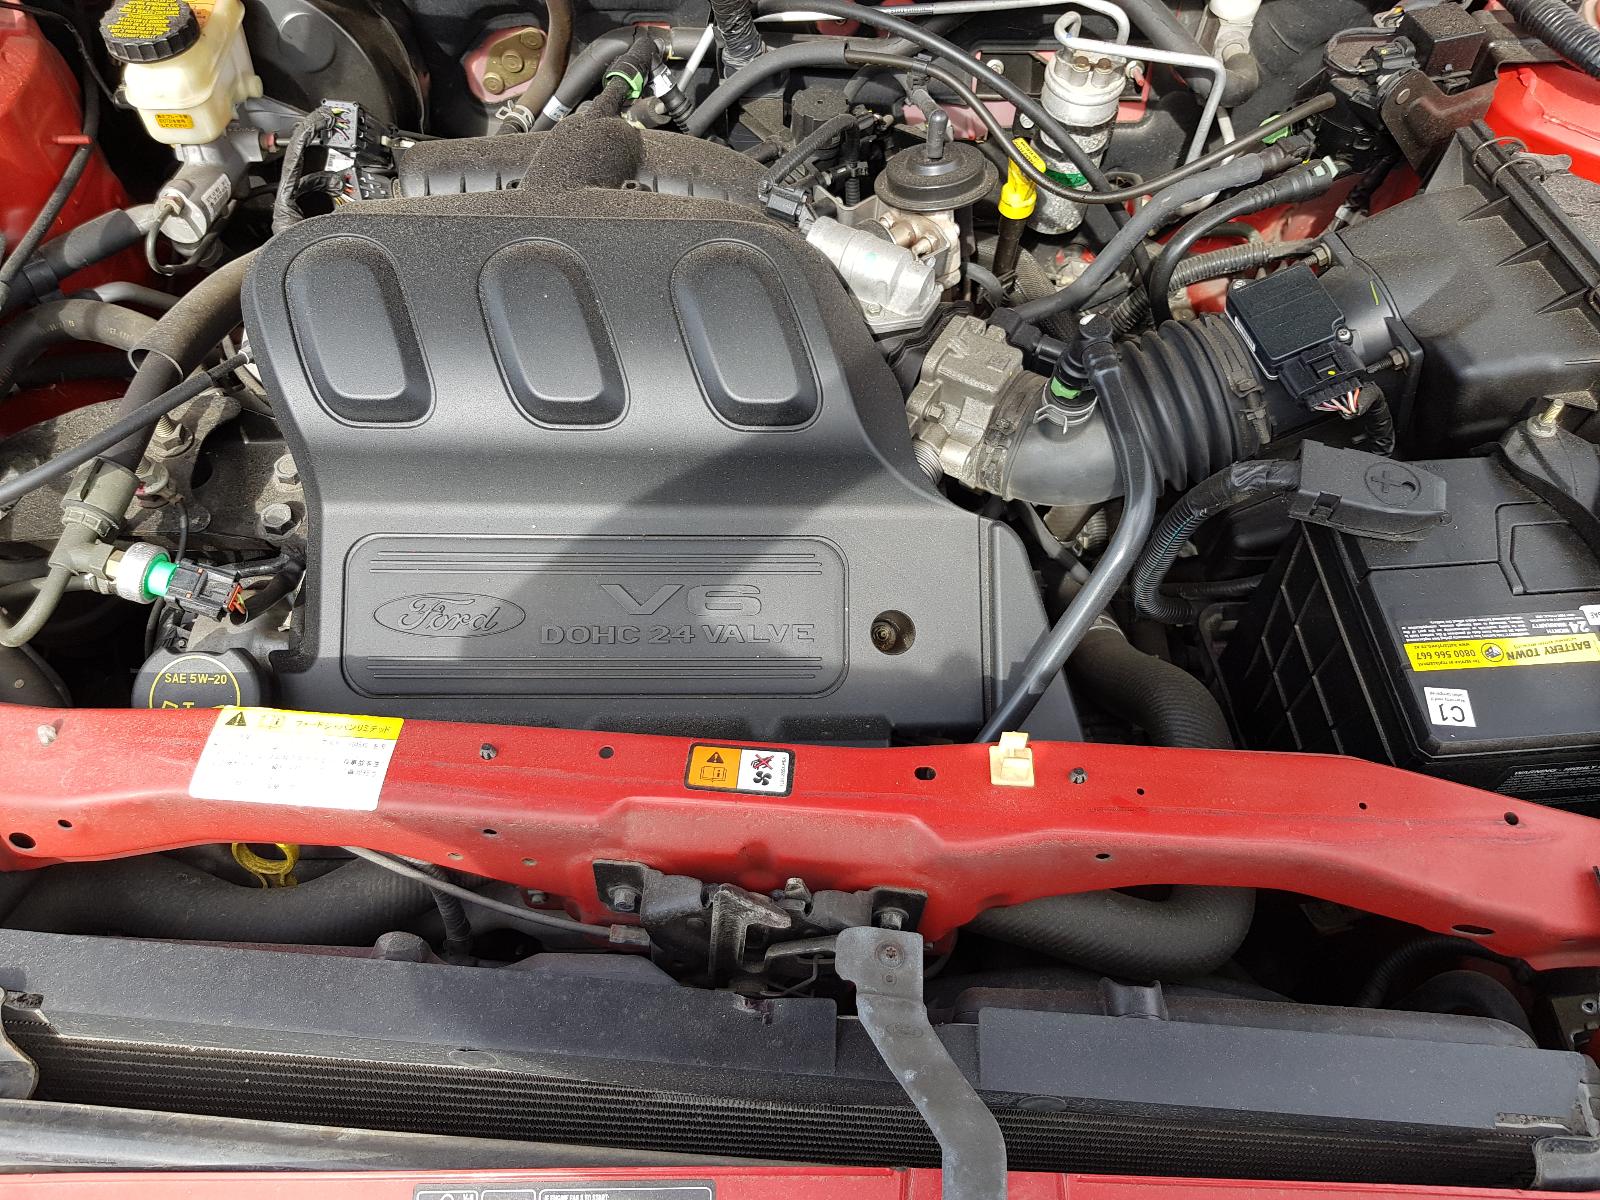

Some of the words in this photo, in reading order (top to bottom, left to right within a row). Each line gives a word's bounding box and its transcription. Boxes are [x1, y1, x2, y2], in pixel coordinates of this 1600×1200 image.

[599, 582, 763, 617] V6
[397, 596, 501, 632] Ford
[539, 623, 641, 645] DOHC
[647, 623, 697, 645] 24
[703, 622, 816, 643] VALVE
[1568, 620, 1590, 634] 24
[1415, 651, 1433, 660] 667
[1434, 650, 1452, 659] 566
[1453, 649, 1476, 658] 0800
[1505, 646, 1541, 661] TOWN
[1544, 640, 1592, 656] BATTERY
[164, 673, 187, 684] SAE
[189, 673, 228, 685] 5W-20
[1438, 703, 1466, 723] C1
